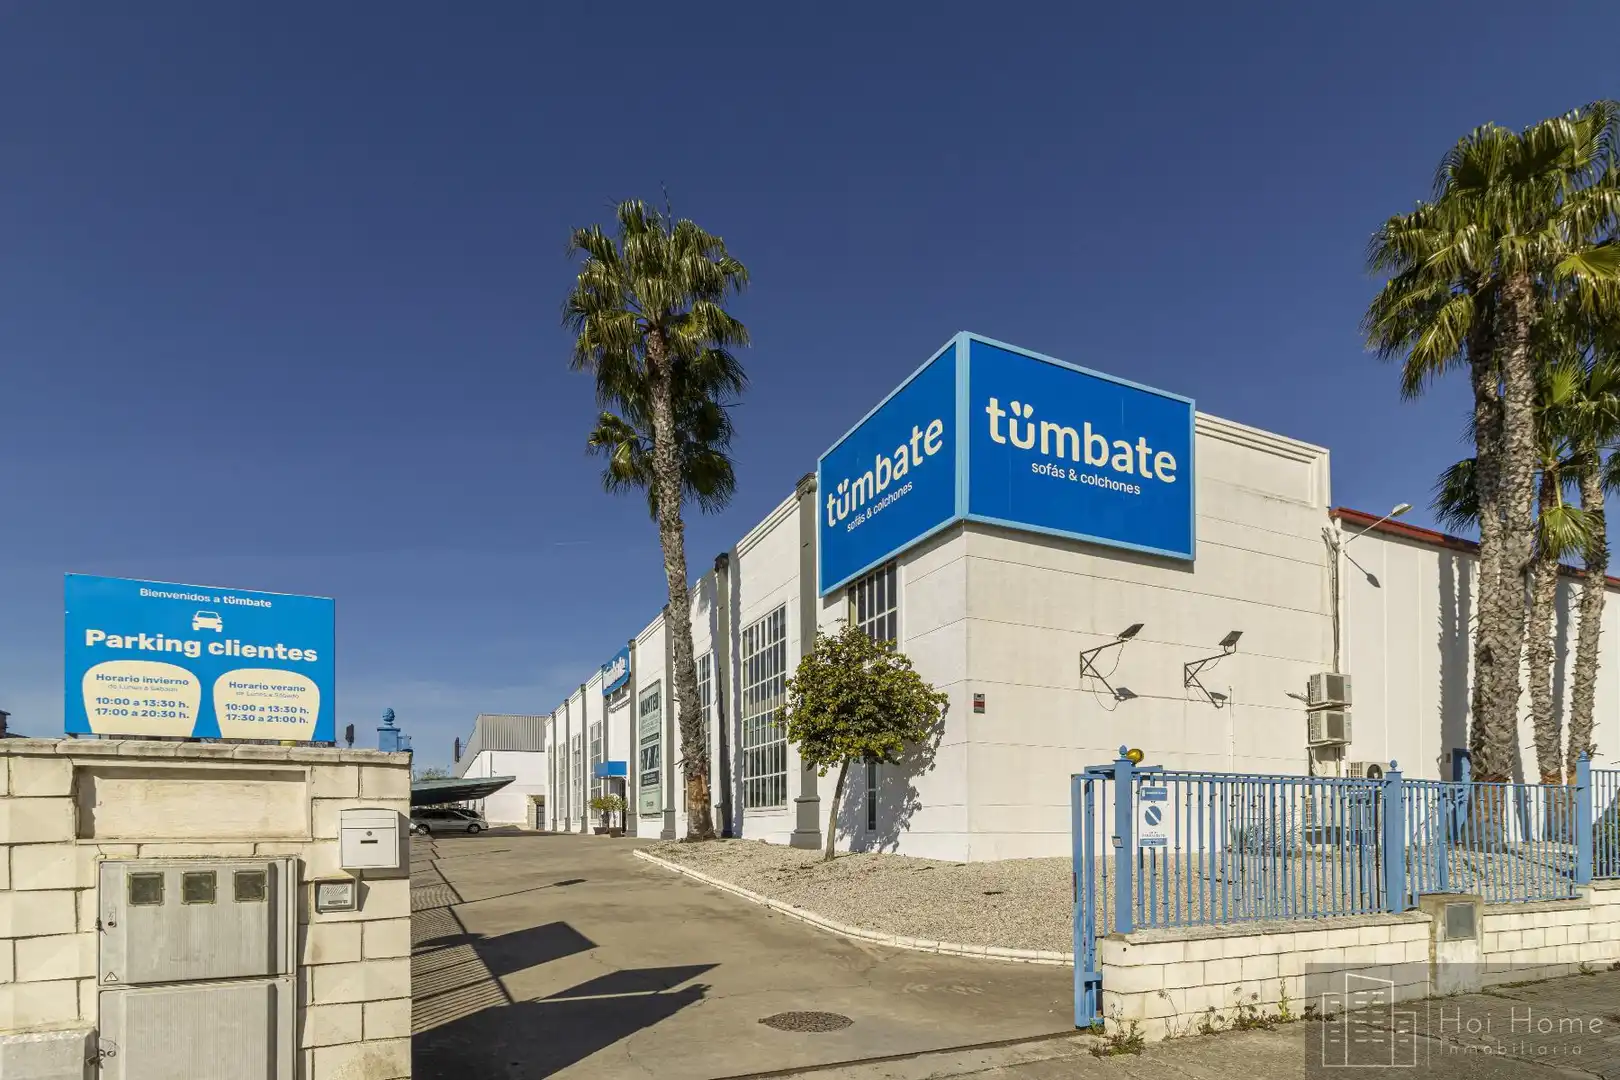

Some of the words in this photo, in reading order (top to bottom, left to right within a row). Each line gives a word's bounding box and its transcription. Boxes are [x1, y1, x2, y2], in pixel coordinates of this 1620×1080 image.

[985, 397, 1177, 484] tümbate
[826, 418, 944, 528] tümbate
[1031, 461, 1066, 479] sofás
[1068, 468, 1078, 481] &
[1080, 472, 1141, 495] colchones
[847, 513, 866, 532] sofás
[866, 507, 872, 519] &
[873, 481, 913, 515] colchones
[139, 588, 211, 603] Bienvenidos
[223, 595, 272, 608] tümbate
[85, 628, 201, 658] Parking
[208, 639, 318, 662] clientes
[96, 674, 140, 683] Horario
[143, 676, 189, 686] invierno
[229, 682, 269, 690] Horario
[96, 697, 130, 706] 10:00
[142, 699, 176, 708] 13:30
[225, 703, 256, 711] 10:00
[268, 705, 297, 714] 13:30
[95, 708, 128, 716] 17:00
[141, 709, 176, 718] 20:30
[179, 711, 190, 719] h.
[225, 713, 255, 721] 17:30
[267, 715, 297, 723] 21:00
[299, 716, 309, 724] h.
